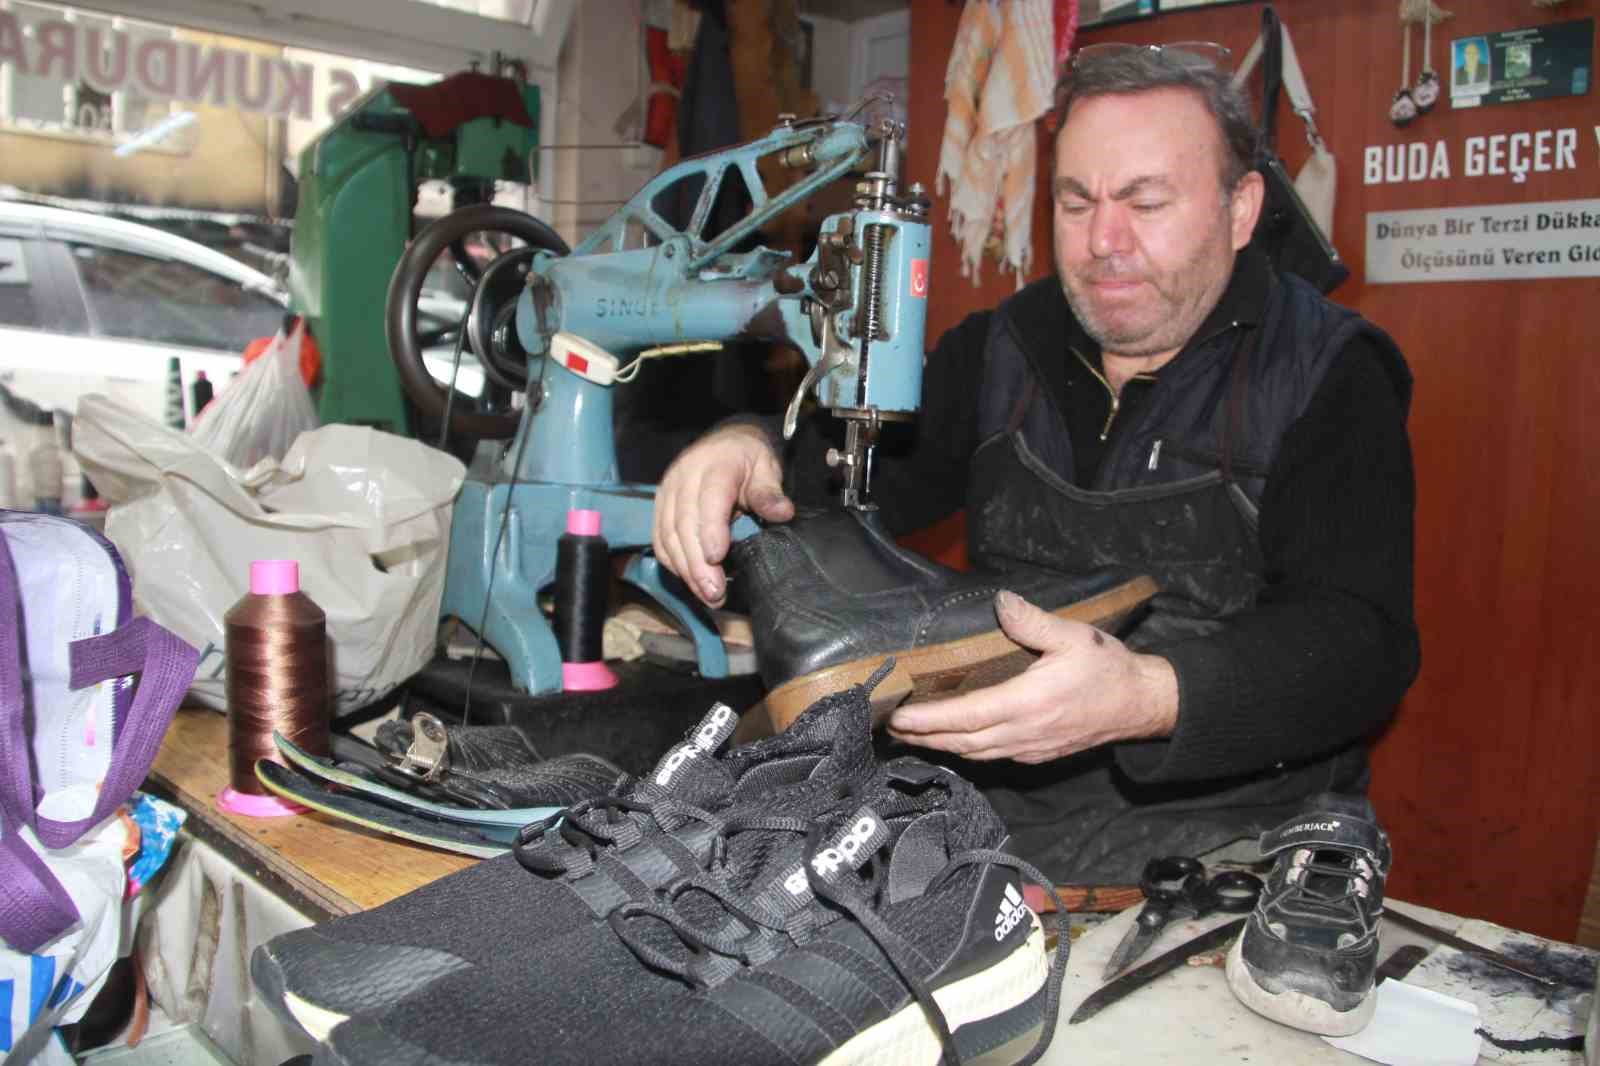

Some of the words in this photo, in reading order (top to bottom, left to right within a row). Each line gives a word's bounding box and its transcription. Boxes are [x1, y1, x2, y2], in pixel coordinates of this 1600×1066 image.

[1363, 140, 1450, 185] BUDA
[1464, 128, 1577, 183] GEÇER
[1376, 221, 1438, 241] Dünya
[1444, 218, 1475, 236] Bir
[1480, 214, 1528, 234] Terzi
[1401, 248, 1495, 272] Ölçüsünü
[1502, 248, 1561, 265] Veren
[994, 903, 1026, 942] adida
